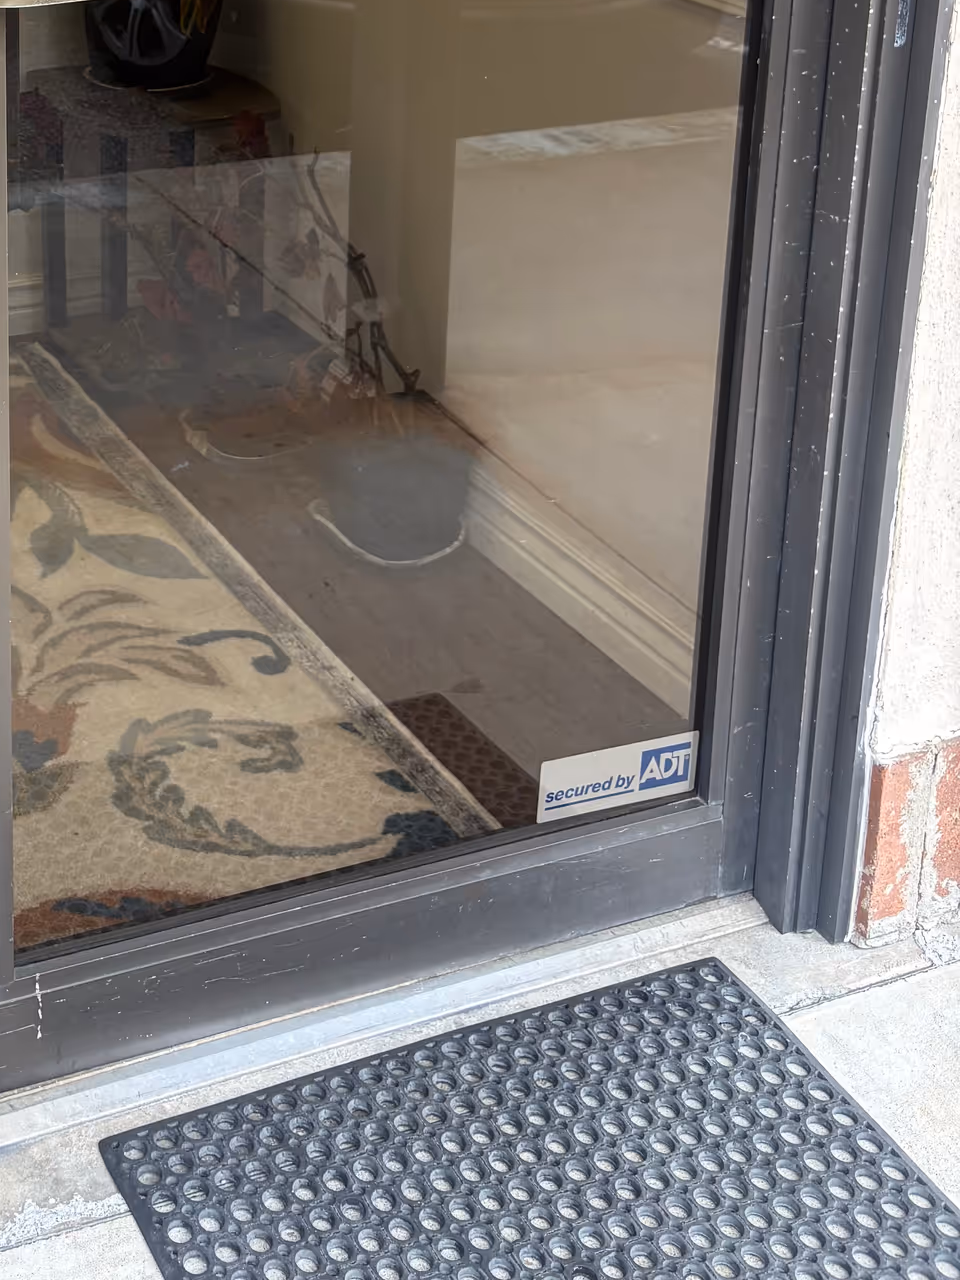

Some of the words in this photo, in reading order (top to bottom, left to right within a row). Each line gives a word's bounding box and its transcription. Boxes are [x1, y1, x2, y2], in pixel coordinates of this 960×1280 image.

[545, 774, 613, 803] secured
[614, 773, 636, 790] by
[640, 749, 690, 784] ADT
